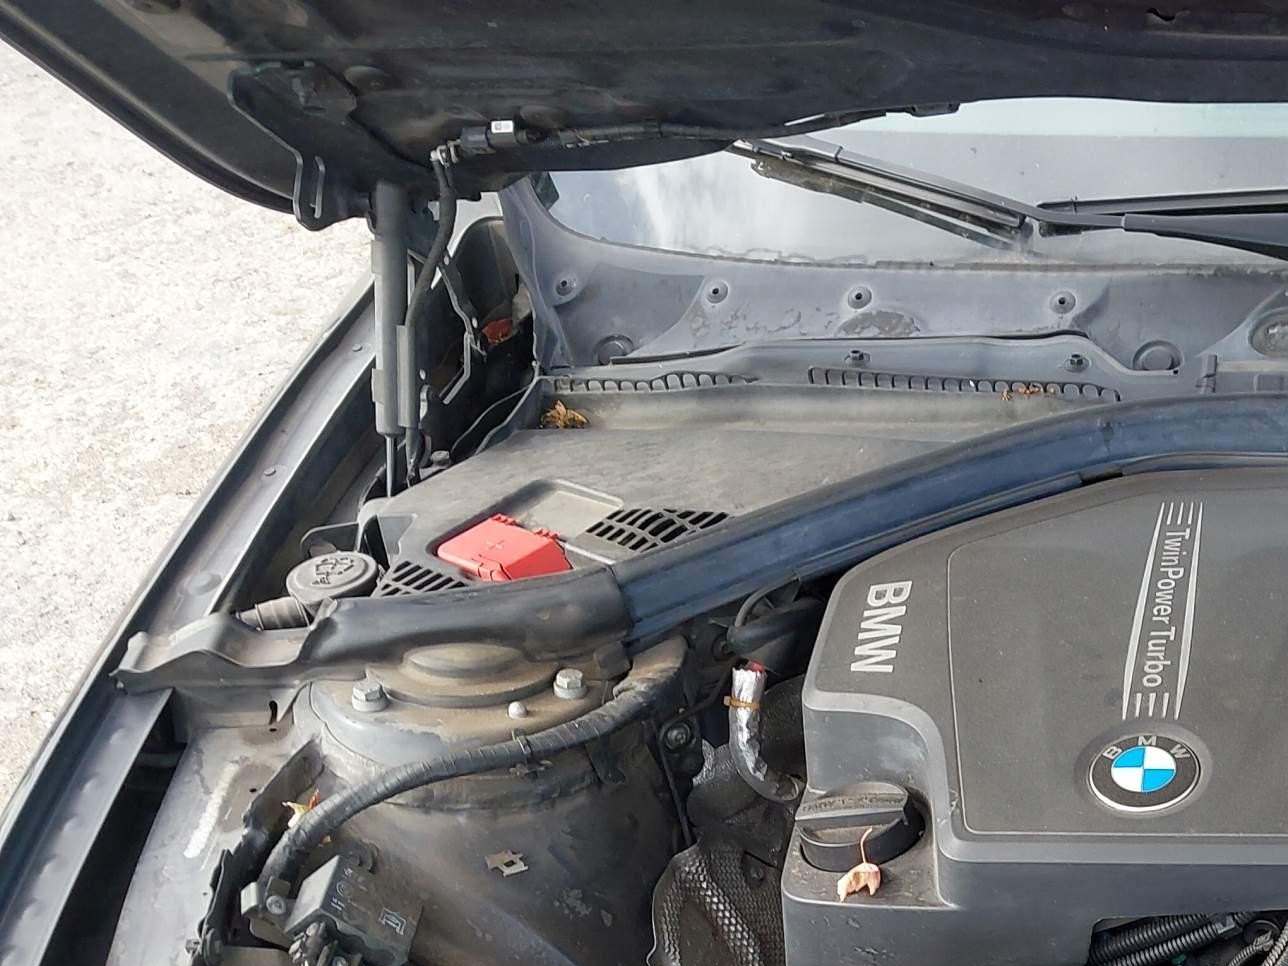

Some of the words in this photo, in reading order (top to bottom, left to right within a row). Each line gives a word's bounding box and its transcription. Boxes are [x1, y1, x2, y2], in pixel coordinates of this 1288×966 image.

[1152, 527, 1191, 623] TwinPower
[850, 580, 913, 673] BMW
[1141, 626, 1177, 688] Turbo
